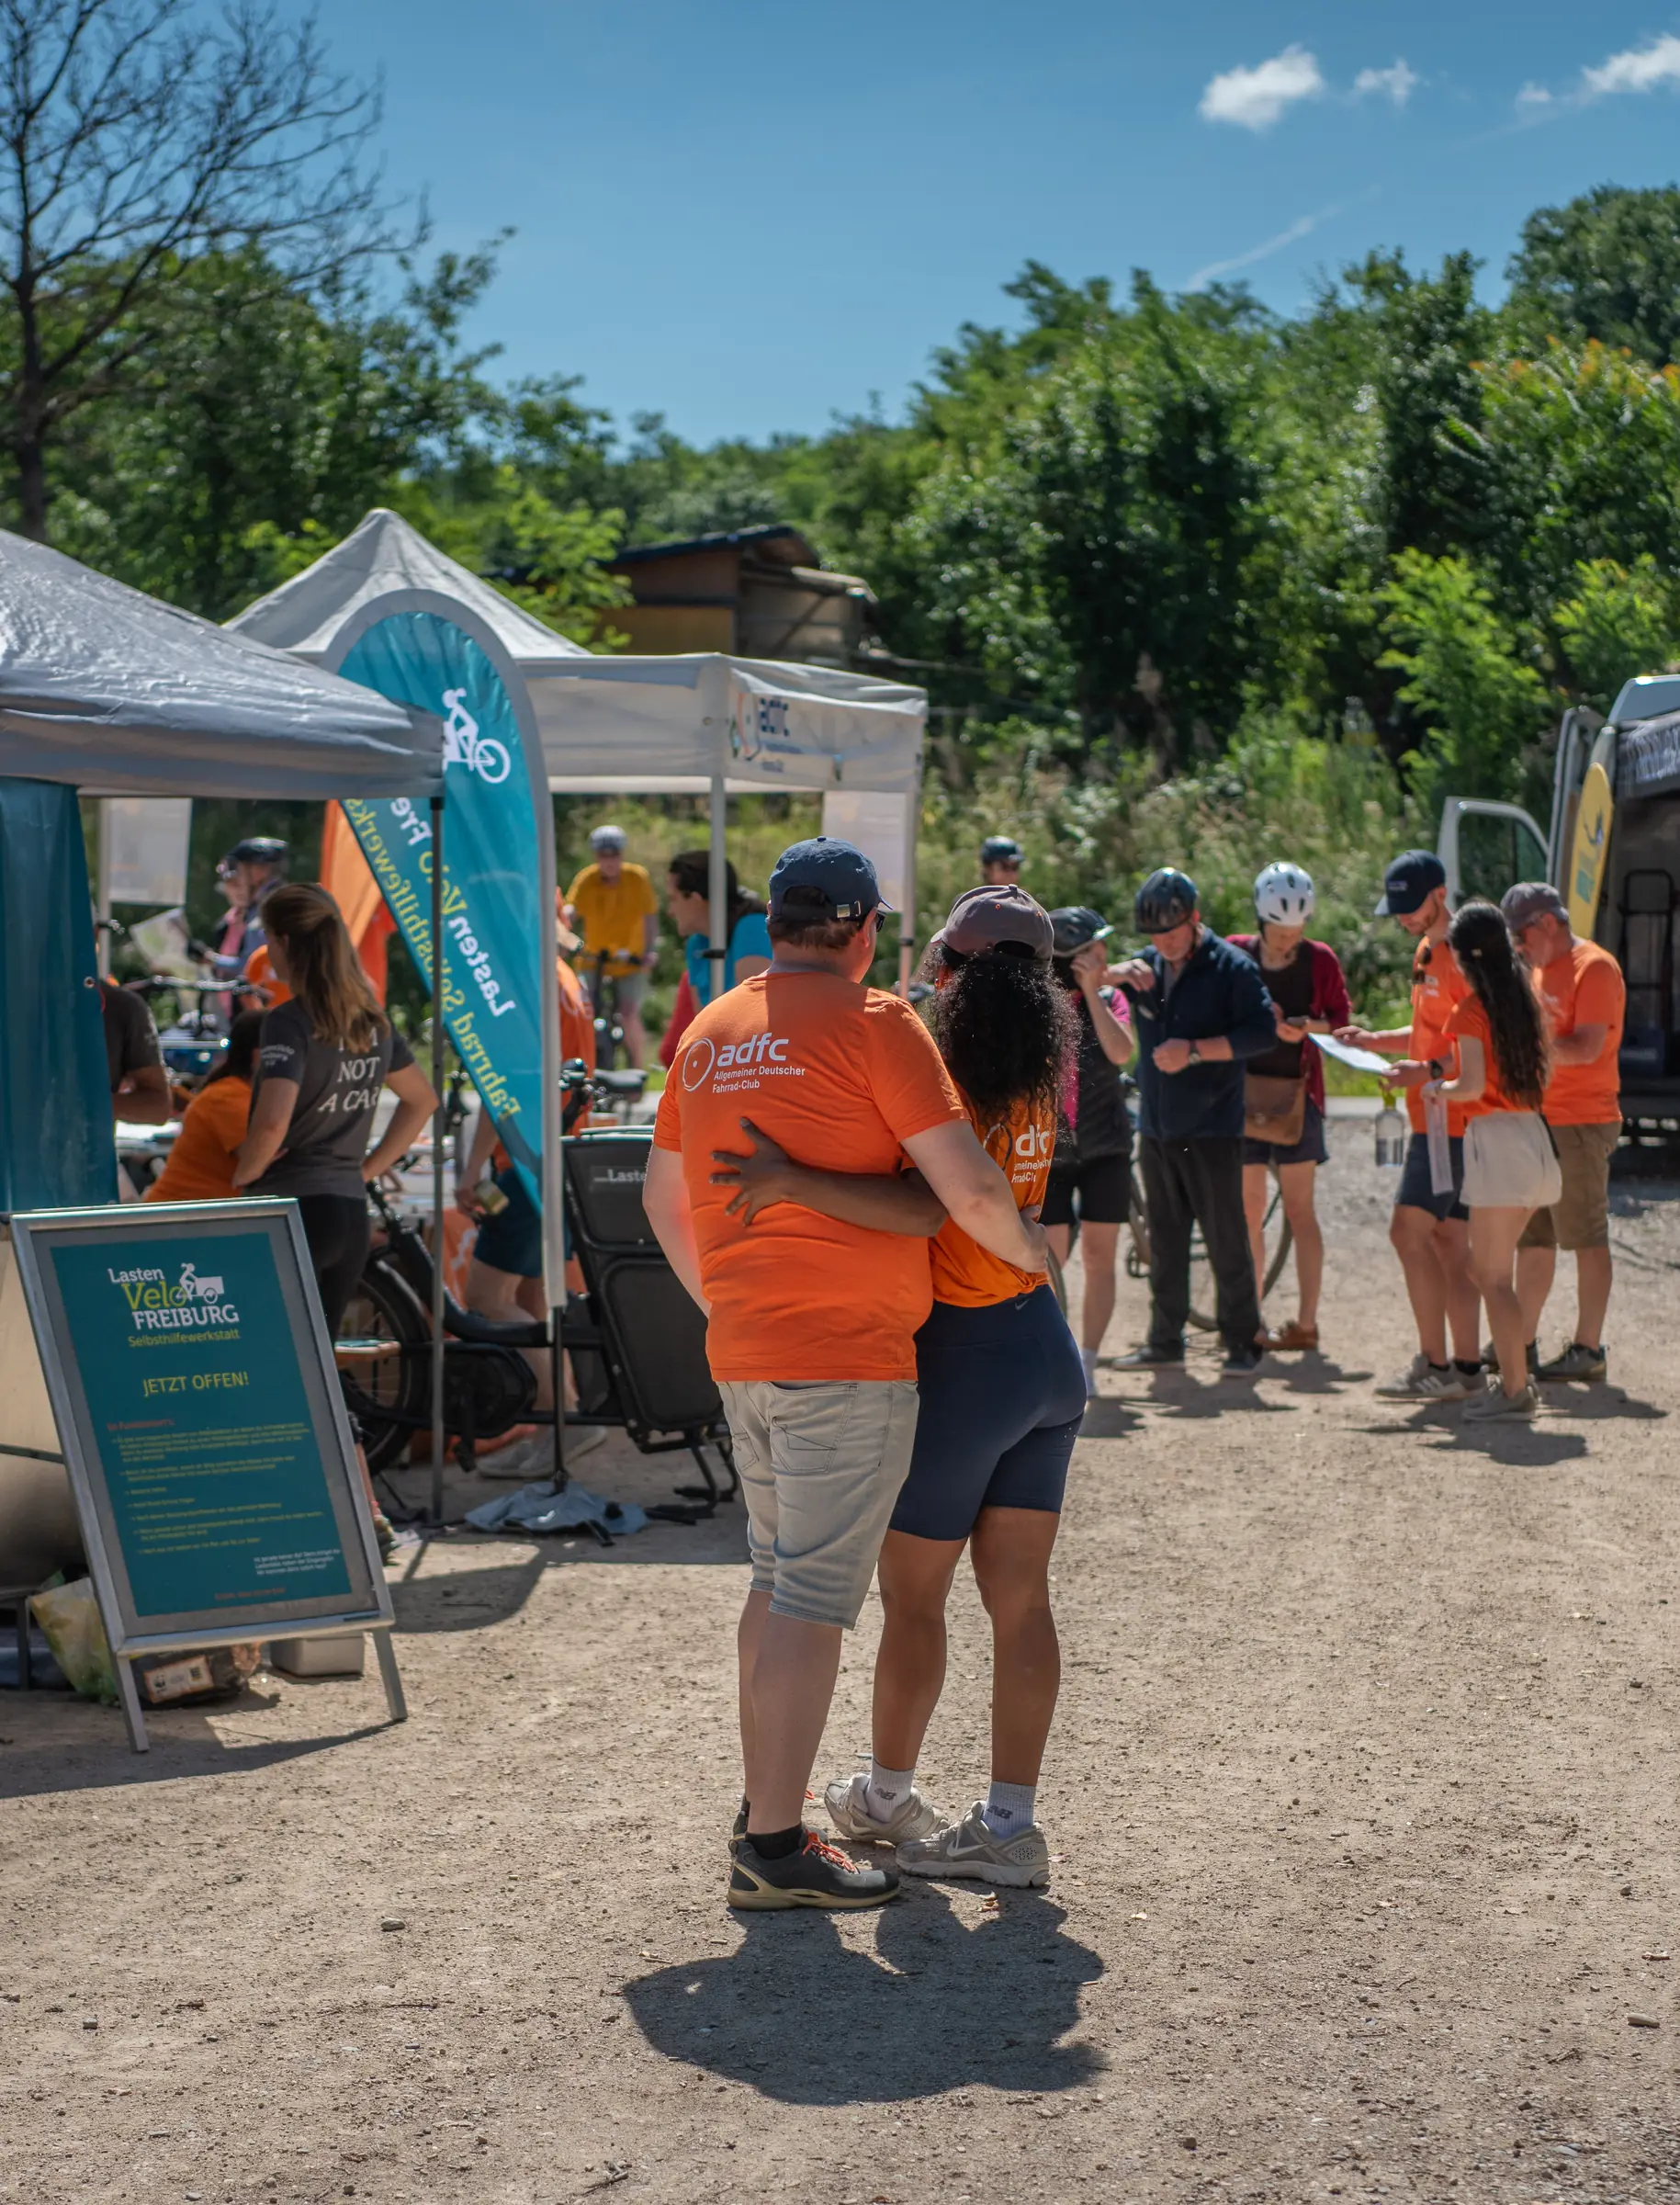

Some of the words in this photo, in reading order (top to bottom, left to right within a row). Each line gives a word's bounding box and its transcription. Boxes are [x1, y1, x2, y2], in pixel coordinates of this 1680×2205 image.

[716, 1033, 789, 1067] adfc
[336, 1057, 382, 1082] NOT
[714, 1068, 757, 1081] Allgemeiner
[759, 1066, 806, 1076] Deutscher
[712, 1080, 761, 1093] Fahrrad-Club
[318, 1093, 338, 1113] A
[107, 1267, 165, 1283] Lasten
[121, 1281, 187, 1310] Velo
[132, 1304, 241, 1330] FREIBURG
[128, 1329, 242, 1348] Selbsthilfewerkstatt
[143, 1376, 187, 1397] JETZT
[192, 1372, 250, 1391] OFFEN!
